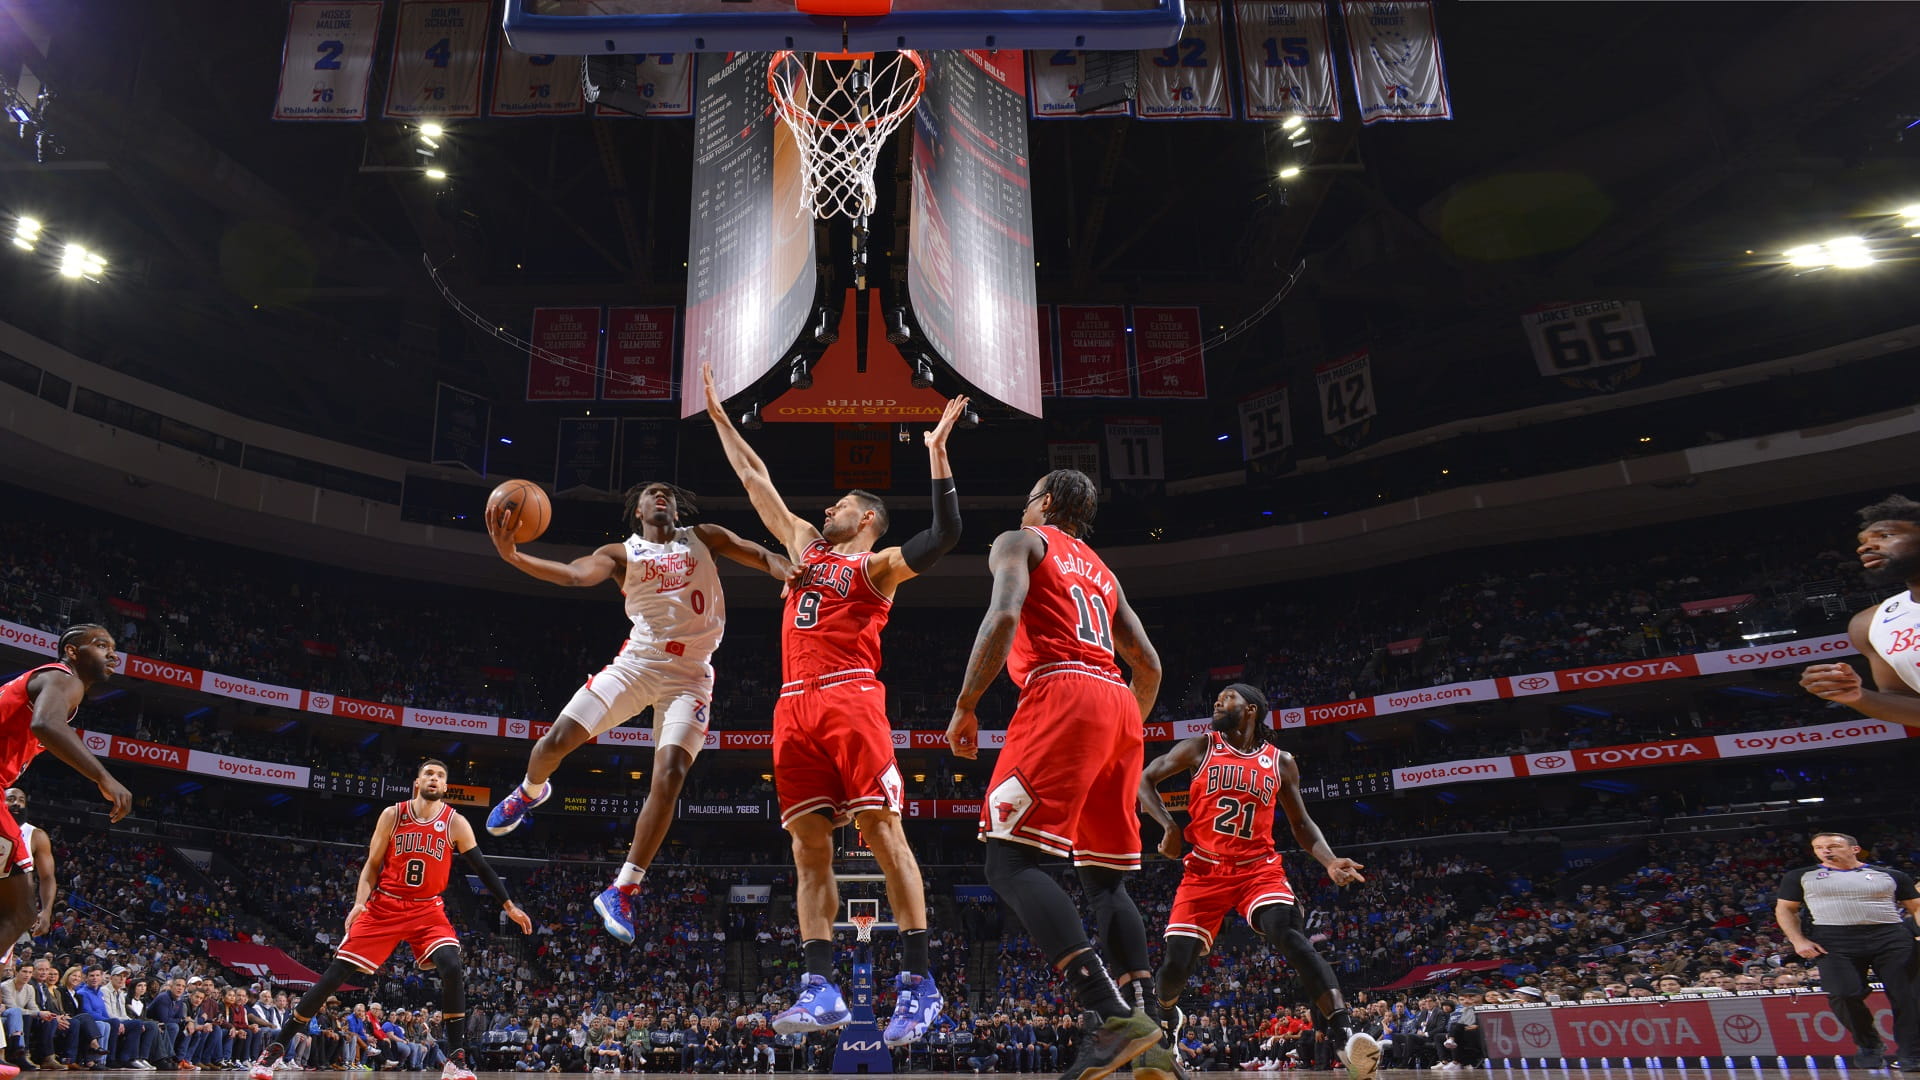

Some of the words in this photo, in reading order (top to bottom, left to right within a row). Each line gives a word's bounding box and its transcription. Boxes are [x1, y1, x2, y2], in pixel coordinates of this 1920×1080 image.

[321, 10, 351, 19] MOSES
[431, 8, 461, 17] DOLPH
[316, 20, 353, 29] MALONE
[314, 40, 344, 70] 2
[425, 38, 450, 68] 4
[1153, 38, 1208, 67] 32
[1262, 37, 1310, 67] 15
[707, 51, 749, 89] PHILADELPHIA
[984, 61, 1006, 82] BULLS
[312, 89, 333, 102] 76
[424, 87, 445, 100] 76
[529, 85, 550, 97] 76
[1171, 87, 1193, 100] 76
[1279, 87, 1301, 100] 76
[1385, 85, 1409, 98] 76
[283, 106, 334, 115] Philadelphia
[1043, 102, 1078, 111] Philadel
[1146, 106, 1198, 114] Philadelphia
[721, 158, 737, 173] TEAM
[737, 146, 753, 162] STATS
[624, 322, 658, 331] EASTERN
[634, 313, 649, 322] NBA
[1536, 309, 1569, 325] JAKE
[617, 331, 664, 340] CONFERENCE
[619, 340, 662, 349] CHAMPIONS
[1544, 312, 1637, 369] 66
[554, 375, 571, 388] 76
[1162, 375, 1179, 386] 76
[1327, 374, 1369, 425] 42
[778, 407, 856, 415] FARGO
[864, 407, 943, 415] WELLS
[1248, 407, 1285, 456] 35
[1120, 437, 1150, 475] 11
[641, 551, 698, 582] Brotherly
[656, 573, 691, 594] Love
[793, 562, 854, 600] ULLS
[690, 589, 705, 615] 0
[794, 590, 823, 629] 9
[1069, 584, 1115, 657] 11
[0, 624, 58, 650] toyota.c
[132, 659, 194, 684] TOYOTA
[214, 677, 290, 702] toyota.com
[1310, 703, 1367, 722] TOYOTA
[1389, 686, 1473, 708] toyota.com
[1566, 661, 1683, 685] TOYOTA
[1725, 639, 1850, 665] toyota.co
[338, 700, 396, 721] TOYOTA
[414, 711, 488, 730] toyota.com
[608, 728, 652, 747] toyota.
[116, 740, 181, 765] TOYOTA
[218, 758, 297, 781] toyota.com
[1400, 762, 1498, 783] toyota.com
[1583, 742, 1702, 765] TOYOTA
[1733, 723, 1888, 750] toyota.com
[313, 774, 326, 782] PHI
[1206, 764, 1275, 807] BULLS
[1327, 783, 1339, 791] PHI
[399, 786, 410, 794] PM
[564, 804, 587, 812] POINTS
[688, 805, 734, 814] PHILADELPHIA
[735, 805, 761, 814] 76ERS
[909, 801, 920, 817] 5
[952, 805, 981, 814] CHICAGO
[1213, 796, 1257, 840] 21
[394, 831, 446, 862] BULLS
[404, 858, 426, 888] 8
[1569, 1016, 1702, 1047] TOYOTA
